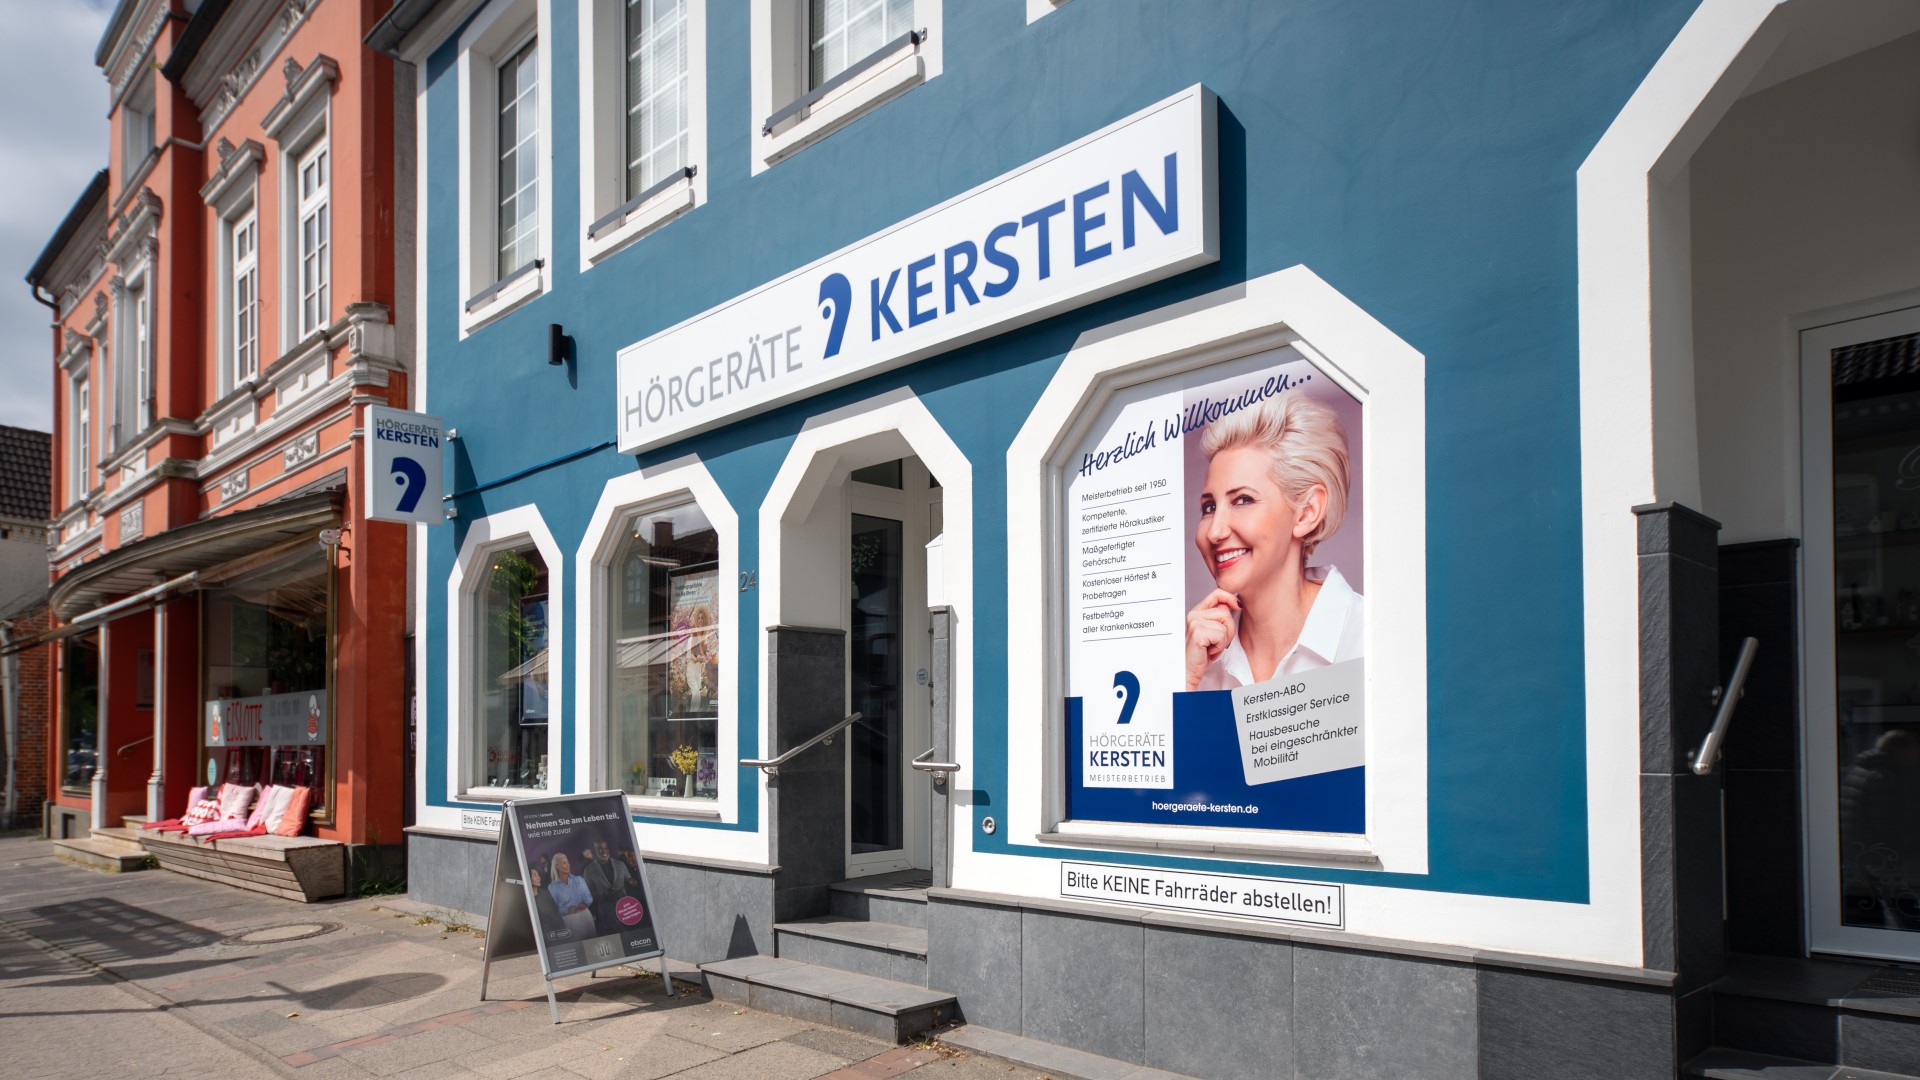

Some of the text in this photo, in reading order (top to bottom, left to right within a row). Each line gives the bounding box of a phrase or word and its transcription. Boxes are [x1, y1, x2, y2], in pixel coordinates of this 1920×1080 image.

[624, 152, 1179, 432] HÖRGERÄTE KERSTEN
[377, 418, 438, 436] HÖRGERÄTE
[1079, 372, 1312, 477] Herzlich Willkommen...
[377, 428, 438, 448] KERSTEN
[1082, 479, 1166, 502] Meisterbetrieb seit 1950
[1082, 507, 1127, 523] Kompetente,
[1082, 514, 1164, 535] zertifizierte Hörakustiker
[1082, 540, 1135, 556] Maßgefertigter
[1082, 555, 1126, 568] Gehörschutz
[739, 570, 756, 592] 24
[1082, 576, 1122, 588] Kostenloser
[1125, 571, 1149, 583] Hörtest
[1082, 588, 1126, 602] Probetragen
[1082, 609, 1124, 623] Festbeträge
[1082, 620, 1154, 633] aller Krankenkassen
[1243, 682, 1306, 706] Kersten-ABO
[1246, 693, 1350, 724] Erstklassiger Service
[1249, 718, 1320, 741] Hausbesuche
[1090, 733, 1165, 747] HÖRGERÄTE
[1251, 725, 1358, 754] bei eingeschränkter
[1090, 750, 1165, 767] KERSTEN
[1254, 750, 1298, 768] Mobilität
[1090, 774, 1165, 783] MEISTERBETRIEB
[1152, 801, 1258, 814] hoergeraete-kersten.de
[464, 815, 472, 824] Bitte
[474, 816, 488, 825] KEINE
[526, 821, 557, 830] Nehmen
[1067, 871, 1331, 914] Bitte KEINE Fahrräder abstellen!
[631, 938, 651, 946] oticon
